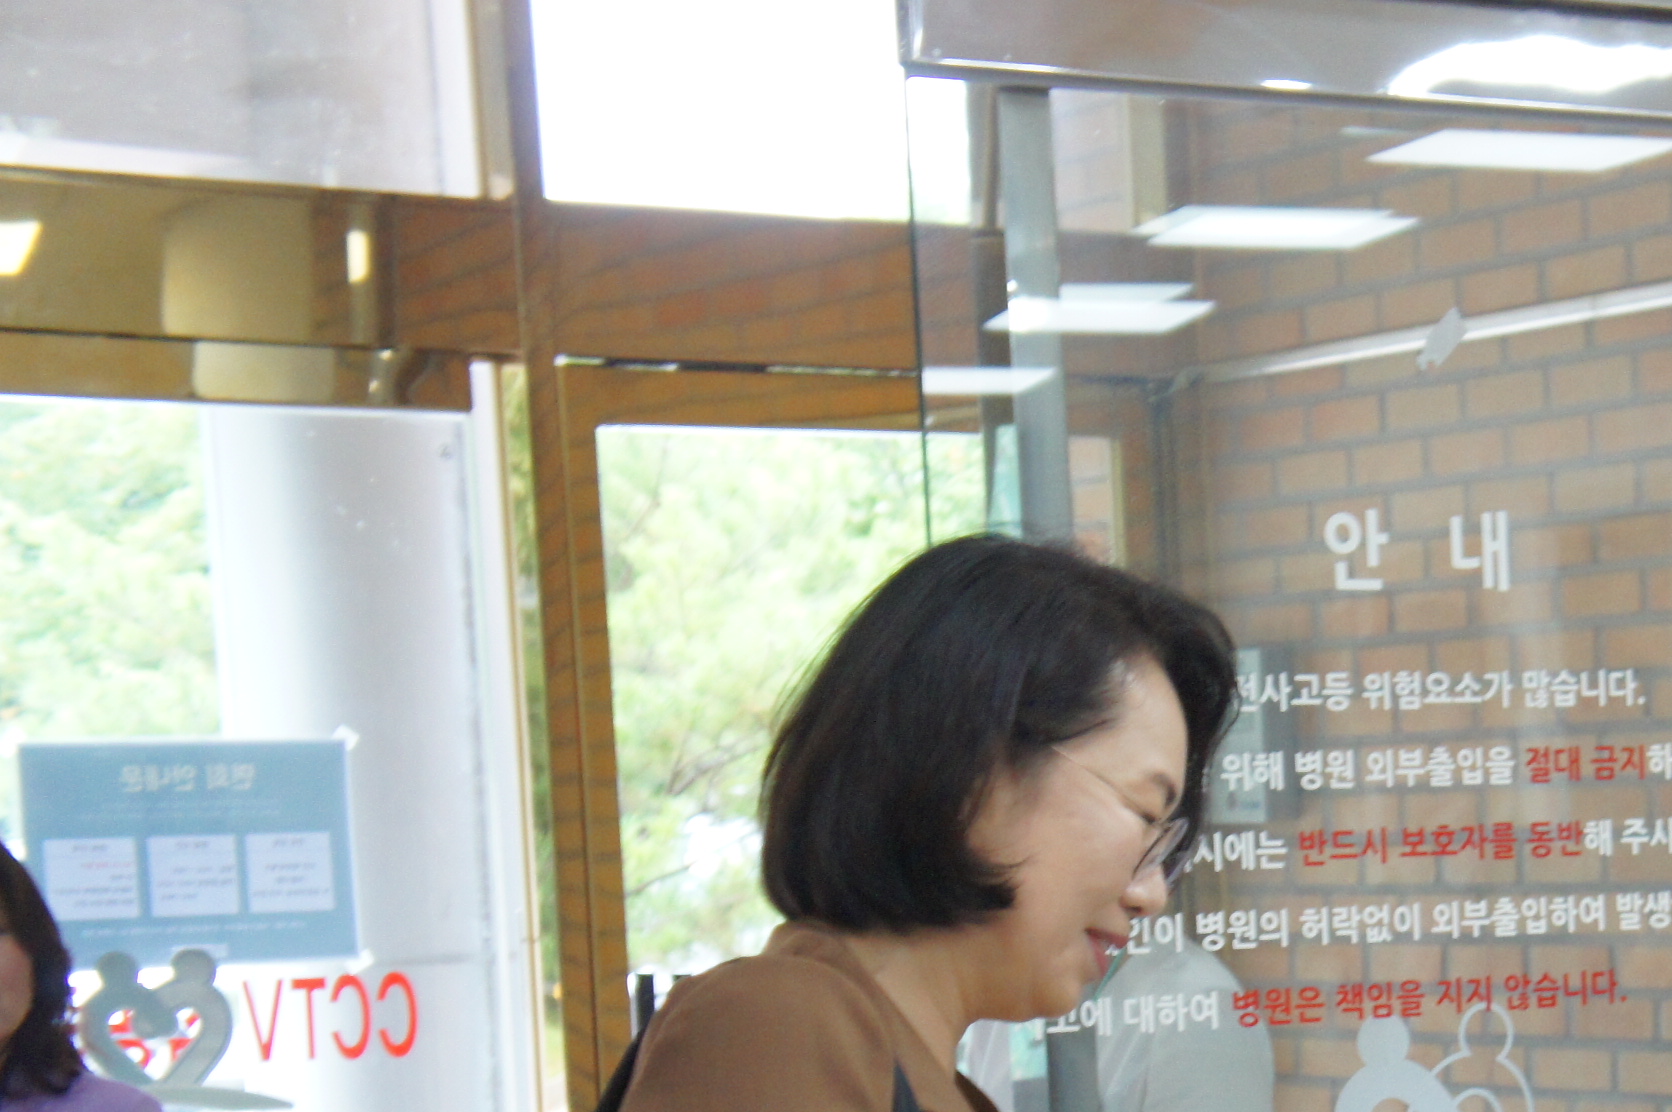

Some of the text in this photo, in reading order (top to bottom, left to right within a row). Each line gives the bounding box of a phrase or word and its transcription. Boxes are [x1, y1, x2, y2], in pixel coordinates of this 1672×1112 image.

[1323, 508, 1512, 592] 안 내
[1361, 669, 1513, 711] 위험요소가
[1521, 667, 1647, 708] 많습니다.
[1219, 750, 1285, 792] 위해
[1294, 748, 1355, 791] 병원
[1364, 745, 1516, 788] 외부출입을
[1525, 743, 1581, 784] 절대
[1184, 829, 1289, 873] 시에는
[1297, 827, 1389, 867] 반드시
[1400, 821, 1518, 861] 보호자를
[1526, 817, 1614, 859] 동반해
[1195, 907, 1290, 952] 병원의
[1299, 901, 1422, 946] 허락없이
[1430, 893, 1607, 940] 외부출입하여
[1123, 990, 1220, 1034] 대하여
[1232, 985, 1326, 1028] 병원은
[1335, 978, 1425, 1021] 책임을
[1435, 974, 1493, 1014] 지지
[1504, 967, 1629, 1012] 않습니다.
